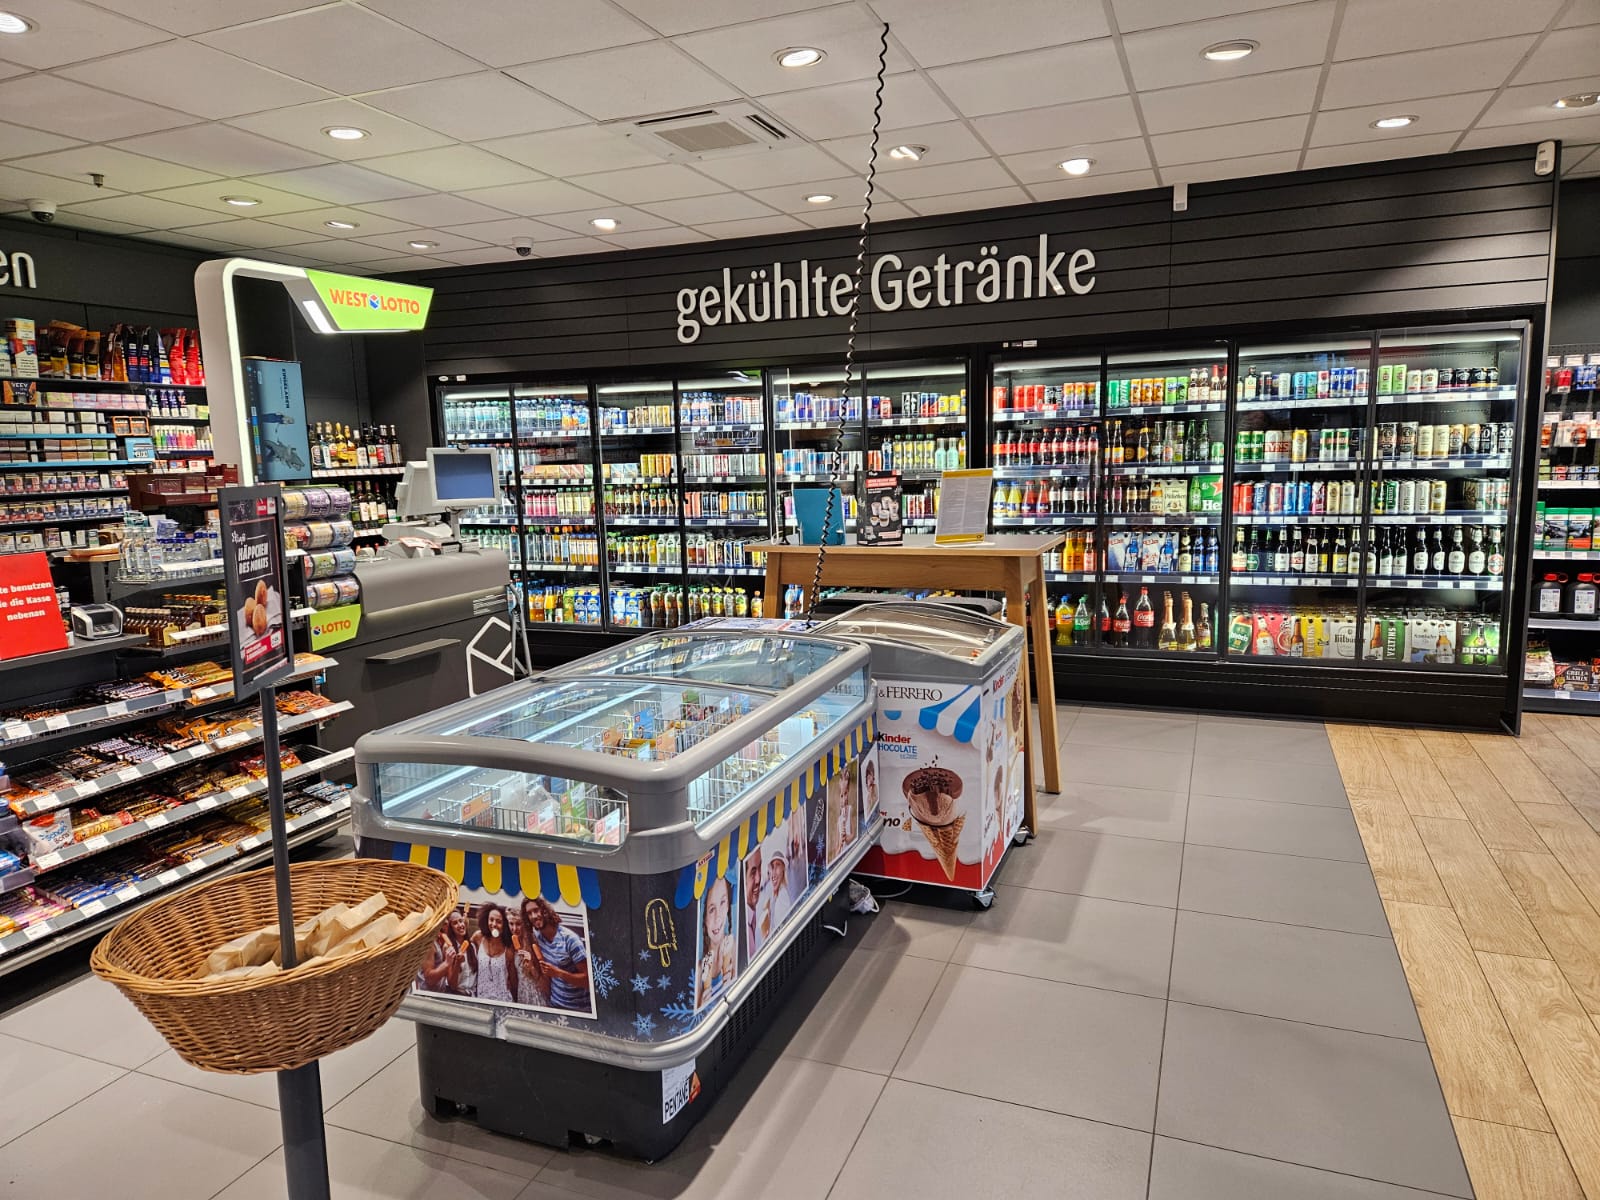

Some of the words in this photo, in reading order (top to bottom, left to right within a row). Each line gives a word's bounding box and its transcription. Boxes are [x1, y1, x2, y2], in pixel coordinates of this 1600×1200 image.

[677, 260, 853, 344] gekühlte
[870, 234, 1096, 312] Getränke
[329, 288, 368, 308] WEST
[381, 296, 420, 315] LOTTO
[11, 582, 52, 593] benutzen
[10, 598, 24, 607] die
[26, 595, 51, 605] Kasse
[7, 610, 46, 621] nebenan
[321, 620, 351, 635] LOTTO
[1387, 627, 1396, 657] VELTINS
[886, 686, 942, 701] FERRERO
[878, 743, 917, 754] HOCOLATE
